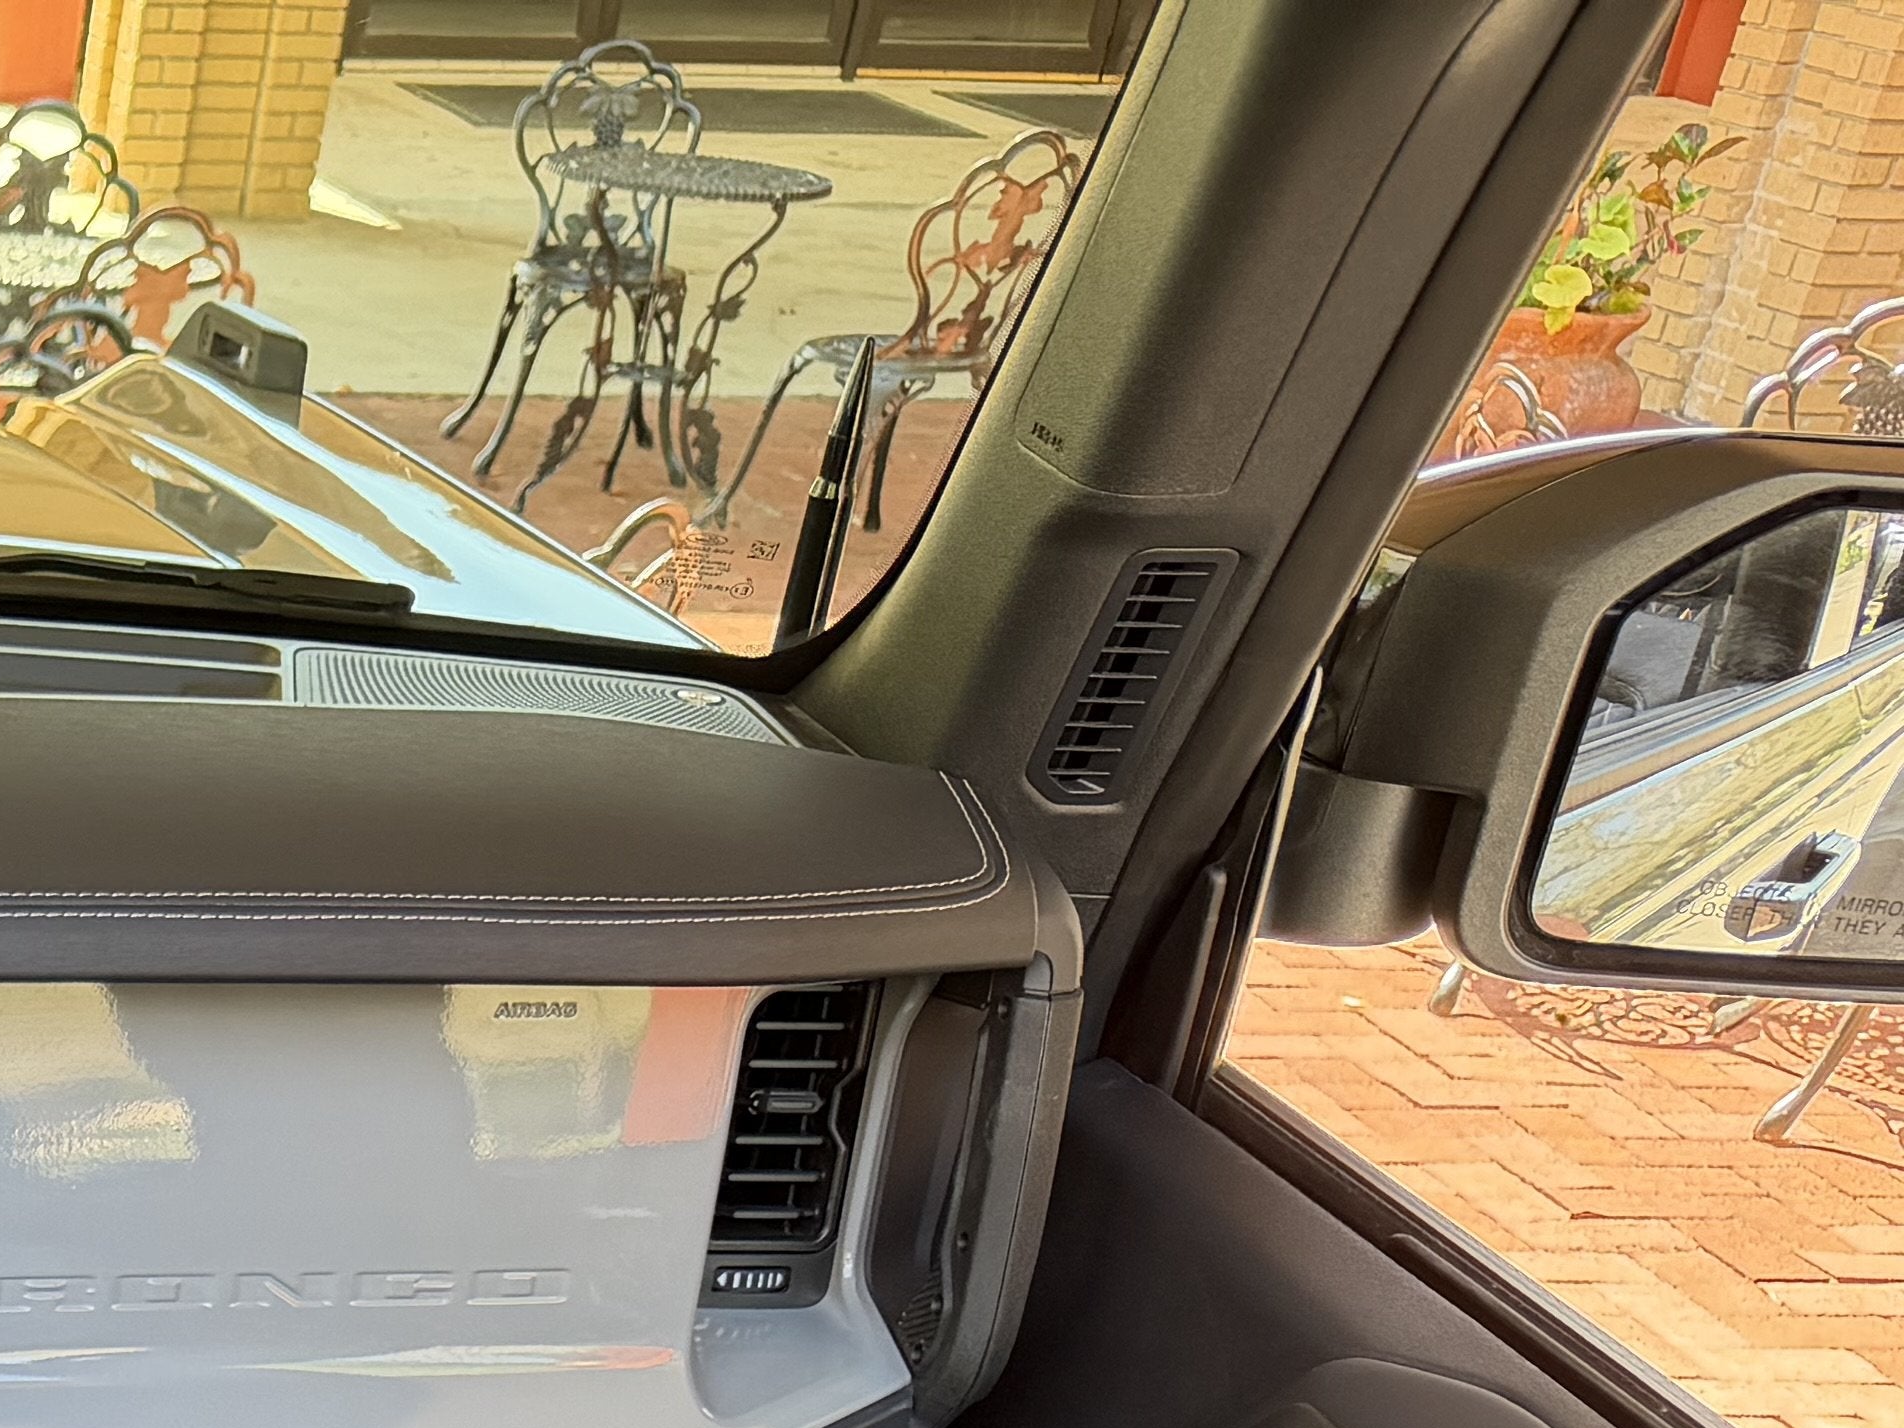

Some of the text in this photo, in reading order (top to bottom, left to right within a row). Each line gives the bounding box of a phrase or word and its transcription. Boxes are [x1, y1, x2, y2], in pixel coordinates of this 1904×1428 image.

[1836, 896, 1904, 917] MIRRO
[1676, 899, 1754, 921] CLOSER
[1834, 917, 1887, 937] THEY
[494, 1002, 577, 1018] AIRBAG
